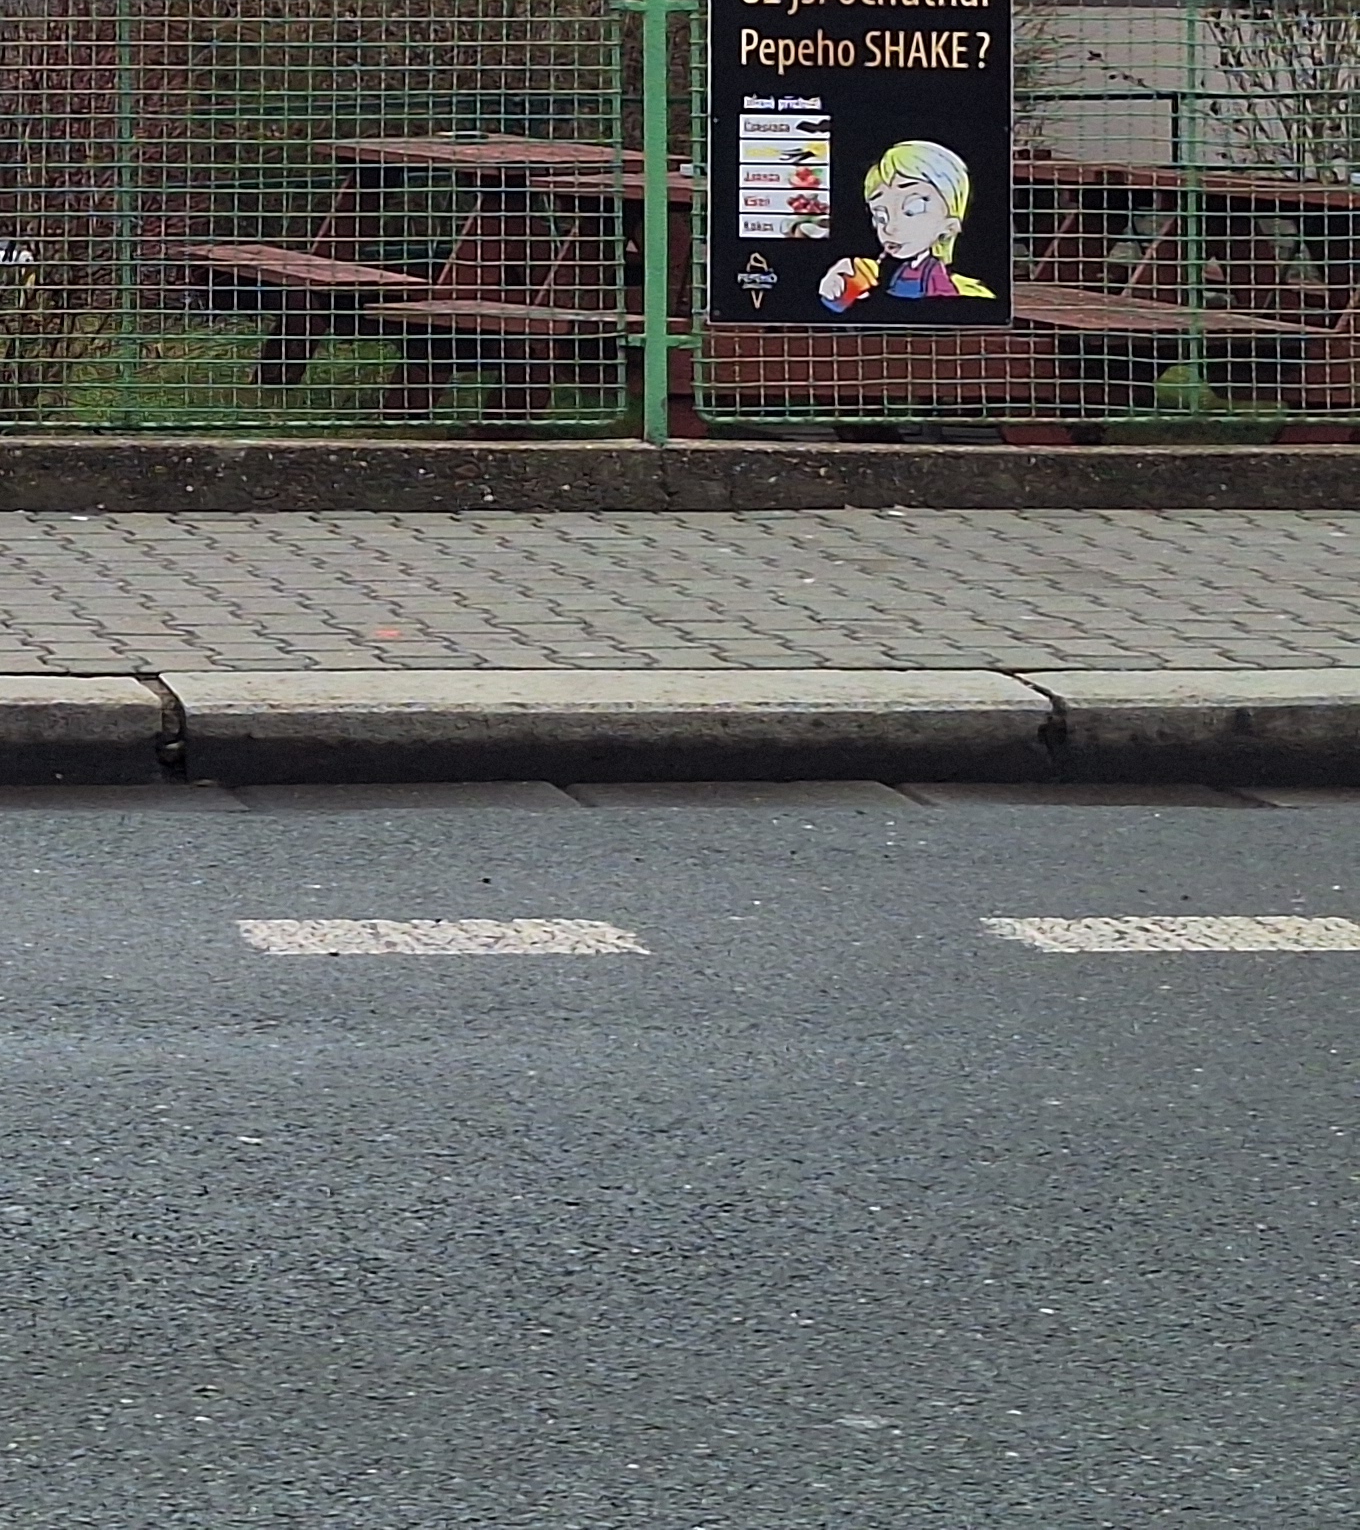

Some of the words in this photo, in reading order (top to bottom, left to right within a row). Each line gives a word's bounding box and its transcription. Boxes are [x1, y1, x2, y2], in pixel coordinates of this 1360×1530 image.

[740, 28, 856, 75] Pepeho
[864, 30, 969, 69] SHAKE
[976, 30, 991, 69] ?
